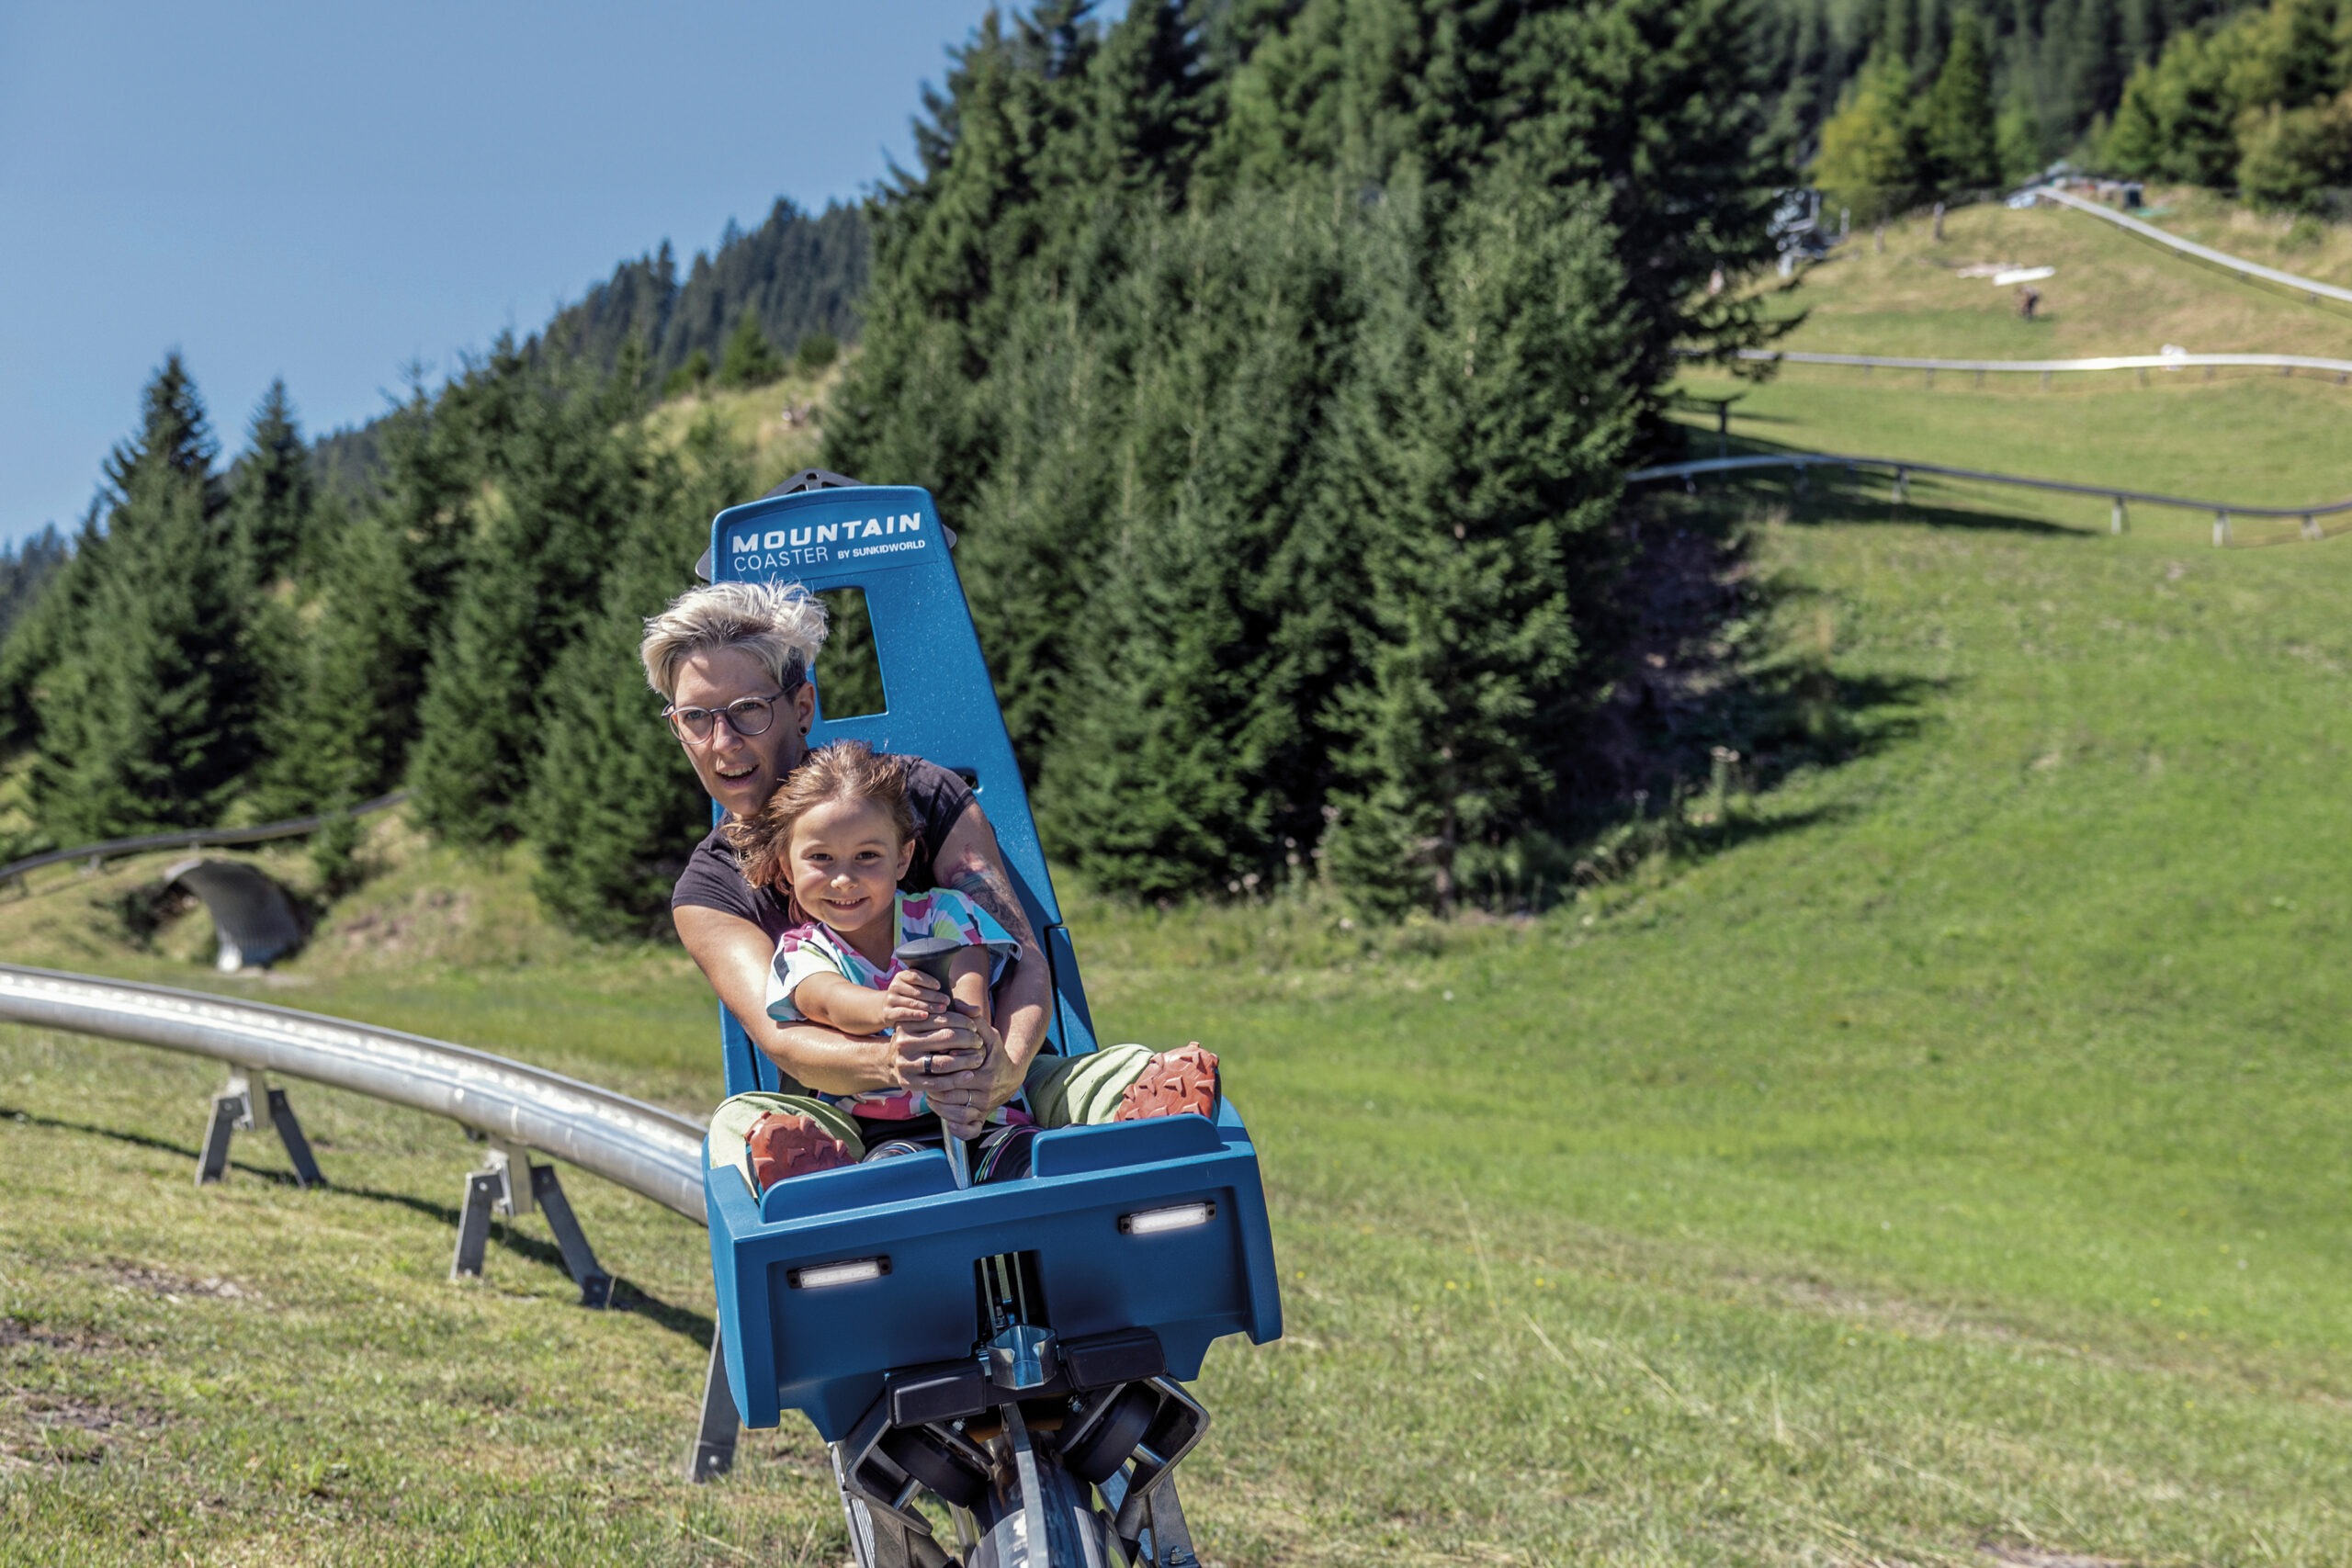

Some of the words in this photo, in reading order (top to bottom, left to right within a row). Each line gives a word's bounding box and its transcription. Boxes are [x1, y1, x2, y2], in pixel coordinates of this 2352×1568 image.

[732, 512, 922, 554] MOUNTAIN
[734, 546, 829, 572] COASTER
[837, 549, 851, 560] BY
[853, 539, 926, 558] SUNKIDWORLD
